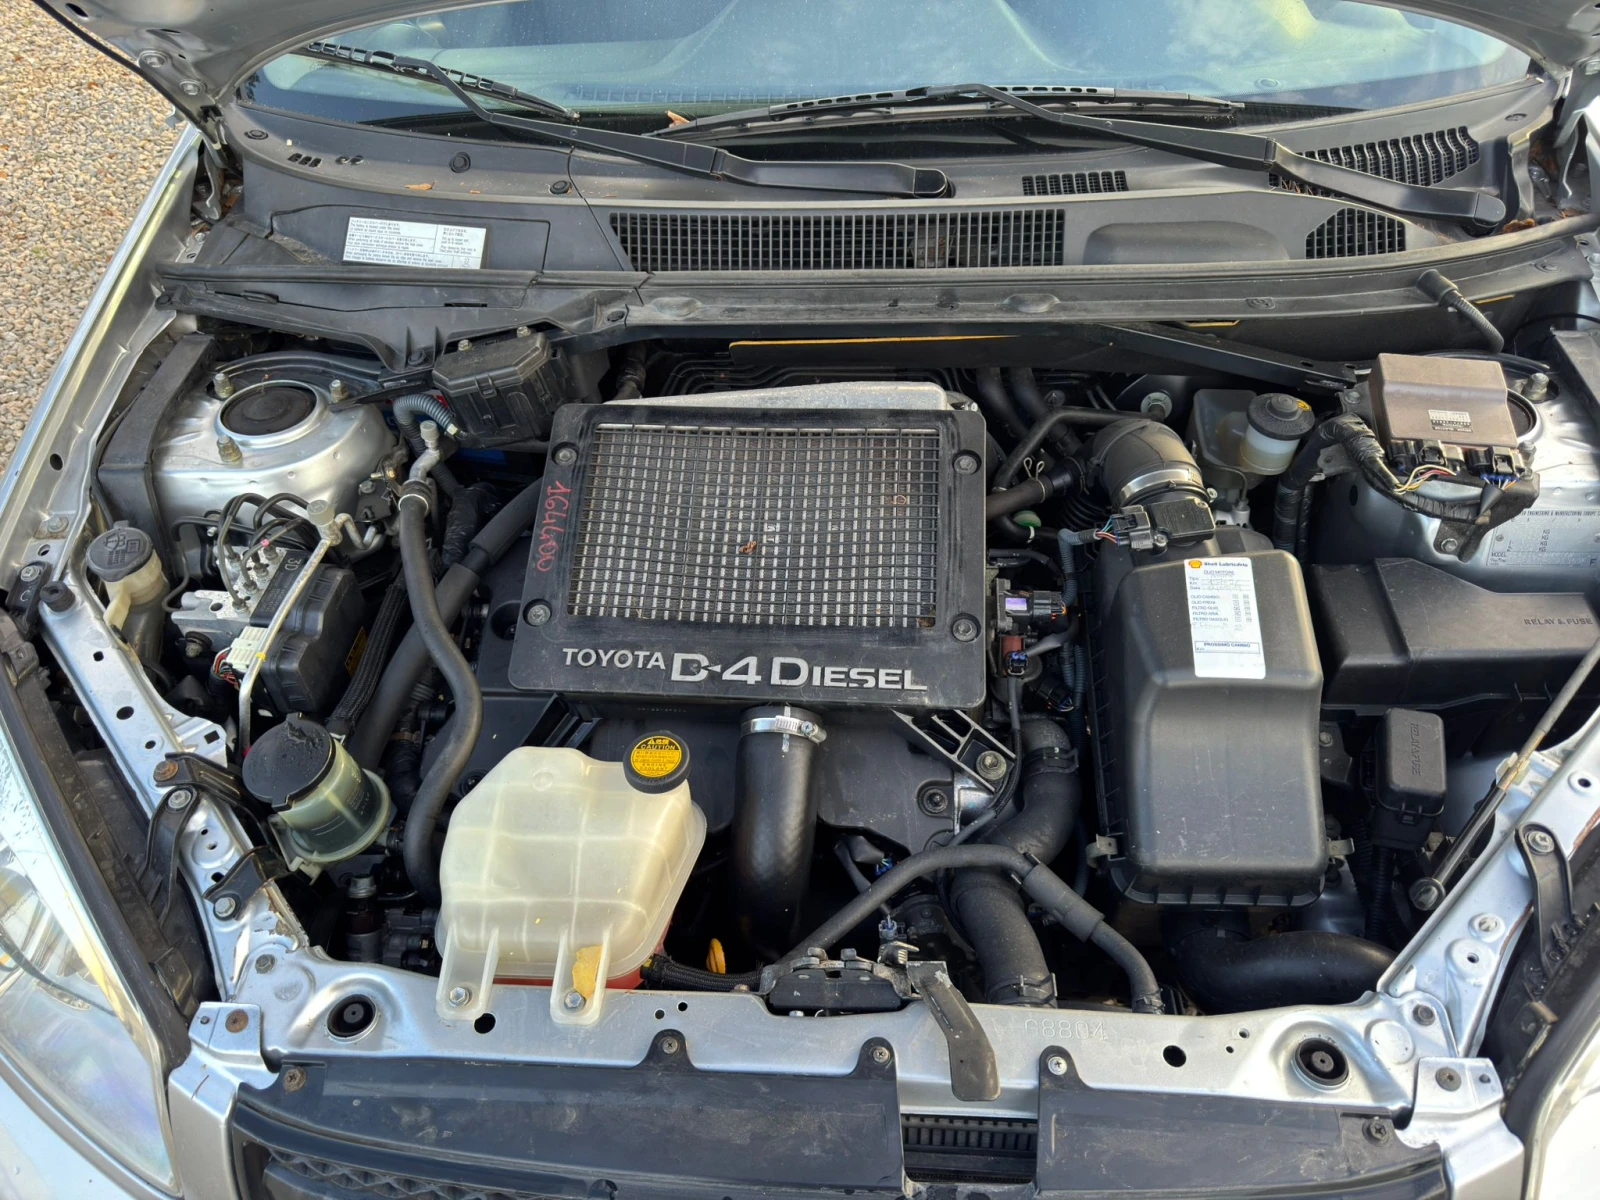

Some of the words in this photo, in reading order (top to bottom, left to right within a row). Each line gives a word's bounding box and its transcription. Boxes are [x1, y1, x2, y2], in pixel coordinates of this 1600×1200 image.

[562, 647, 667, 670] TOYOTA
[671, 652, 762, 686] D-4
[770, 656, 928, 692] DIESEL
